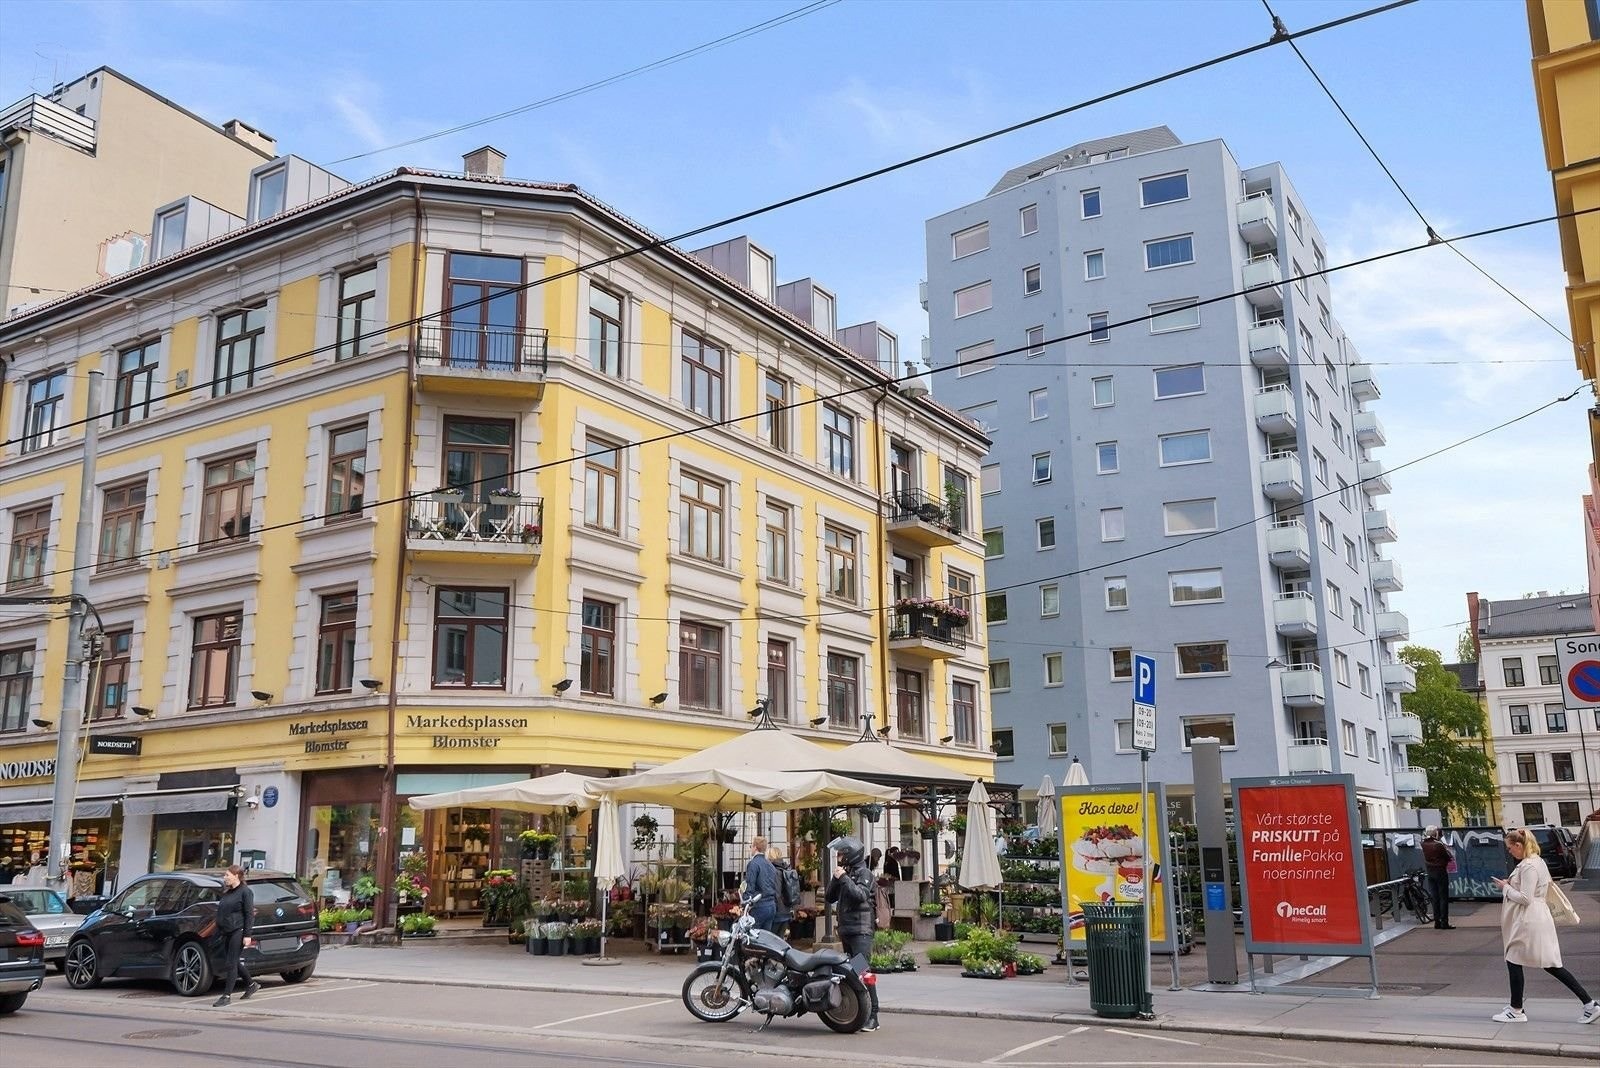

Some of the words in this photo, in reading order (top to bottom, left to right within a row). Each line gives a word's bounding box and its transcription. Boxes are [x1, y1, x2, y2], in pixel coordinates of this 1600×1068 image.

[1566, 641, 1600, 654] Son
[1139, 661, 1151, 698] P
[289, 719, 368, 735] Markedsplassen
[406, 715, 528, 731] Markedsplassen
[97, 740, 132, 748] NORDSETH
[304, 739, 349, 753] Blomster
[432, 735, 501, 748] Blomster
[1079, 801, 1105, 815] Kos
[1107, 802, 1139, 814] dere!
[1256, 812, 1282, 825] Vårt
[1286, 813, 1332, 825] største
[1252, 829, 1320, 843] PRISKUTT
[1323, 828, 1339, 845] på
[1253, 845, 1344, 862] FamiliePakka
[1263, 867, 1335, 880] noensinne!
